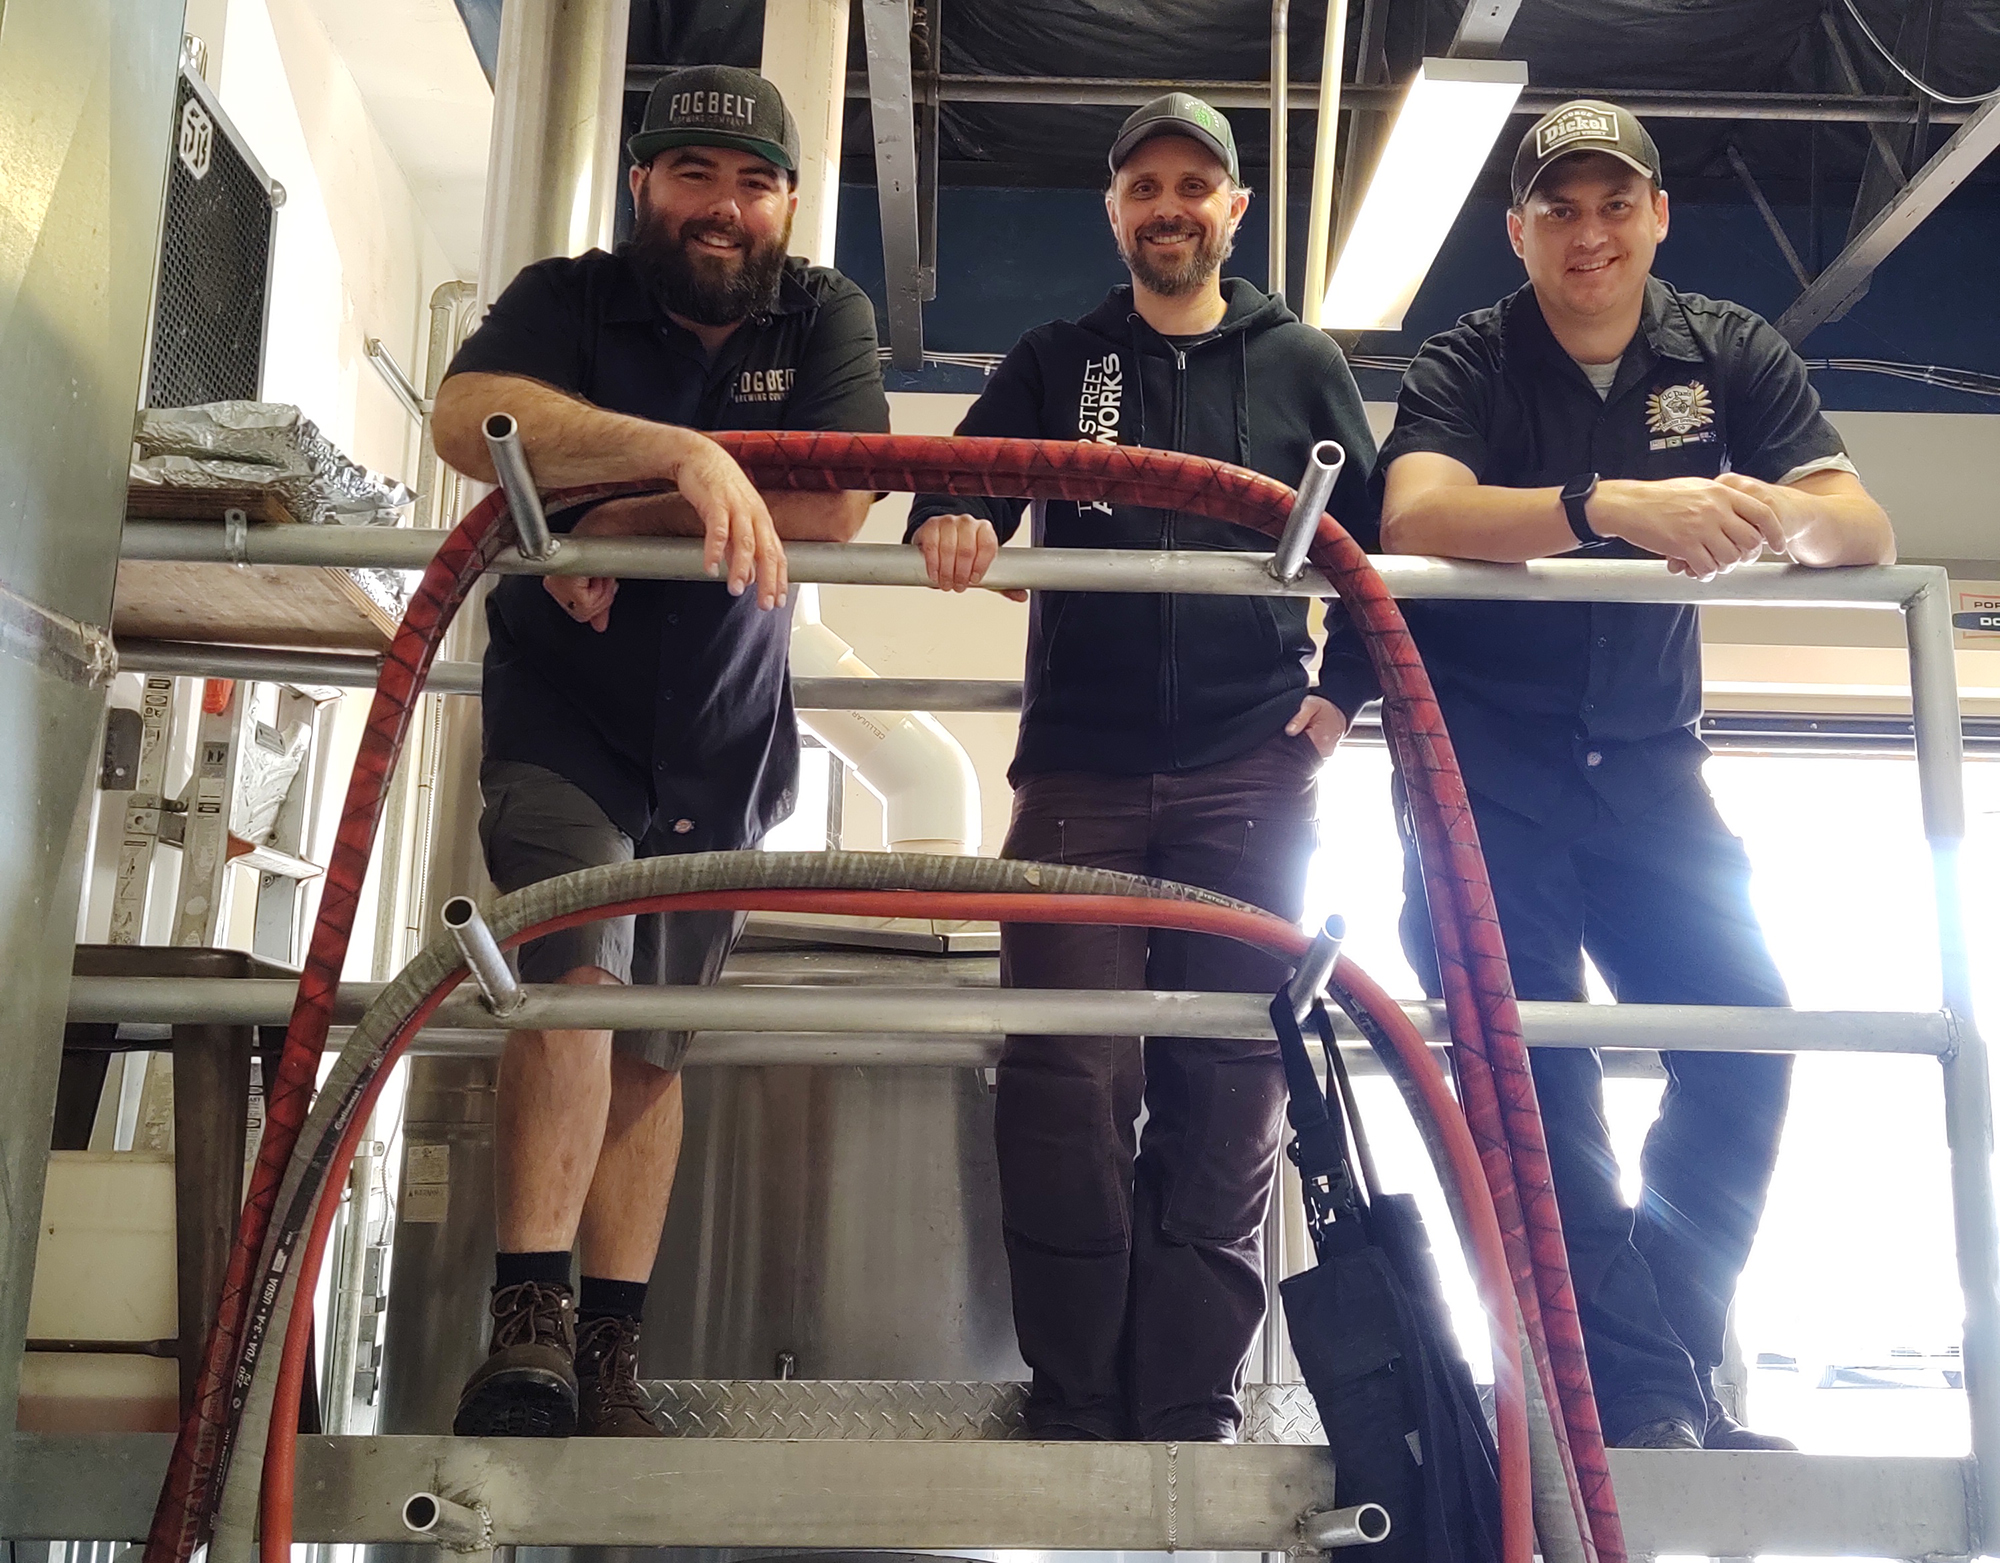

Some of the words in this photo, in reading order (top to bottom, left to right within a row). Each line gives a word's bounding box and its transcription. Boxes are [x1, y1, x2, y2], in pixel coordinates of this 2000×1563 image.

[669, 91, 756, 125] FOGBELT
[1545, 116, 1609, 144] Dickel
[1079, 359, 1102, 435] STREET
[851, 711, 886, 740] CELLULAR
[235, 1365, 246, 1388] 250
[244, 1342, 258, 1363] FDA
[253, 1315, 266, 1334] 3-A
[262, 1278, 279, 1306] USDA
